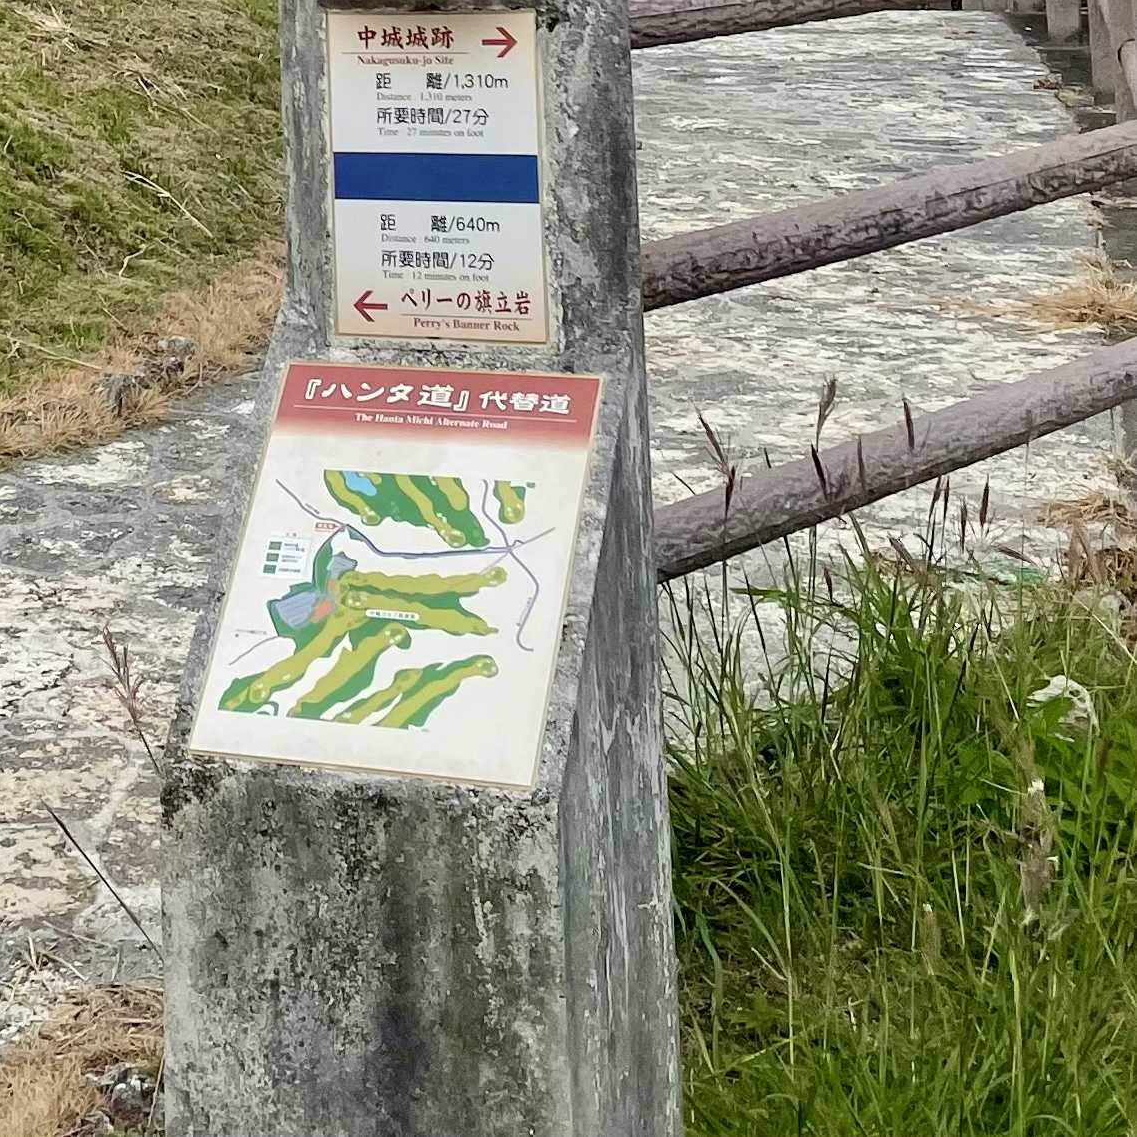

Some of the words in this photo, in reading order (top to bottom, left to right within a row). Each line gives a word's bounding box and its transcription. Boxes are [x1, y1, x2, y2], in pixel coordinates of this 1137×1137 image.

[357, 25, 455, 50] 中城城跡
[376, 107, 490, 126] 所要時間/27分
[377, 127, 399, 136] Time
[381, 249, 495, 271] 所要時間/12分
[382, 270, 404, 280] Time
[401, 288, 532, 315] ペリーの旗立岩
[413, 317, 450, 330] Perry's
[453, 319, 491, 331] Banner
[494, 320, 520, 332] Rock
[356, 413, 373, 422] The
[375, 414, 404, 424] Hanta
[407, 415, 433, 425] Michi
[436, 417, 480, 429] Alternate
[482, 419, 508, 430] Road
